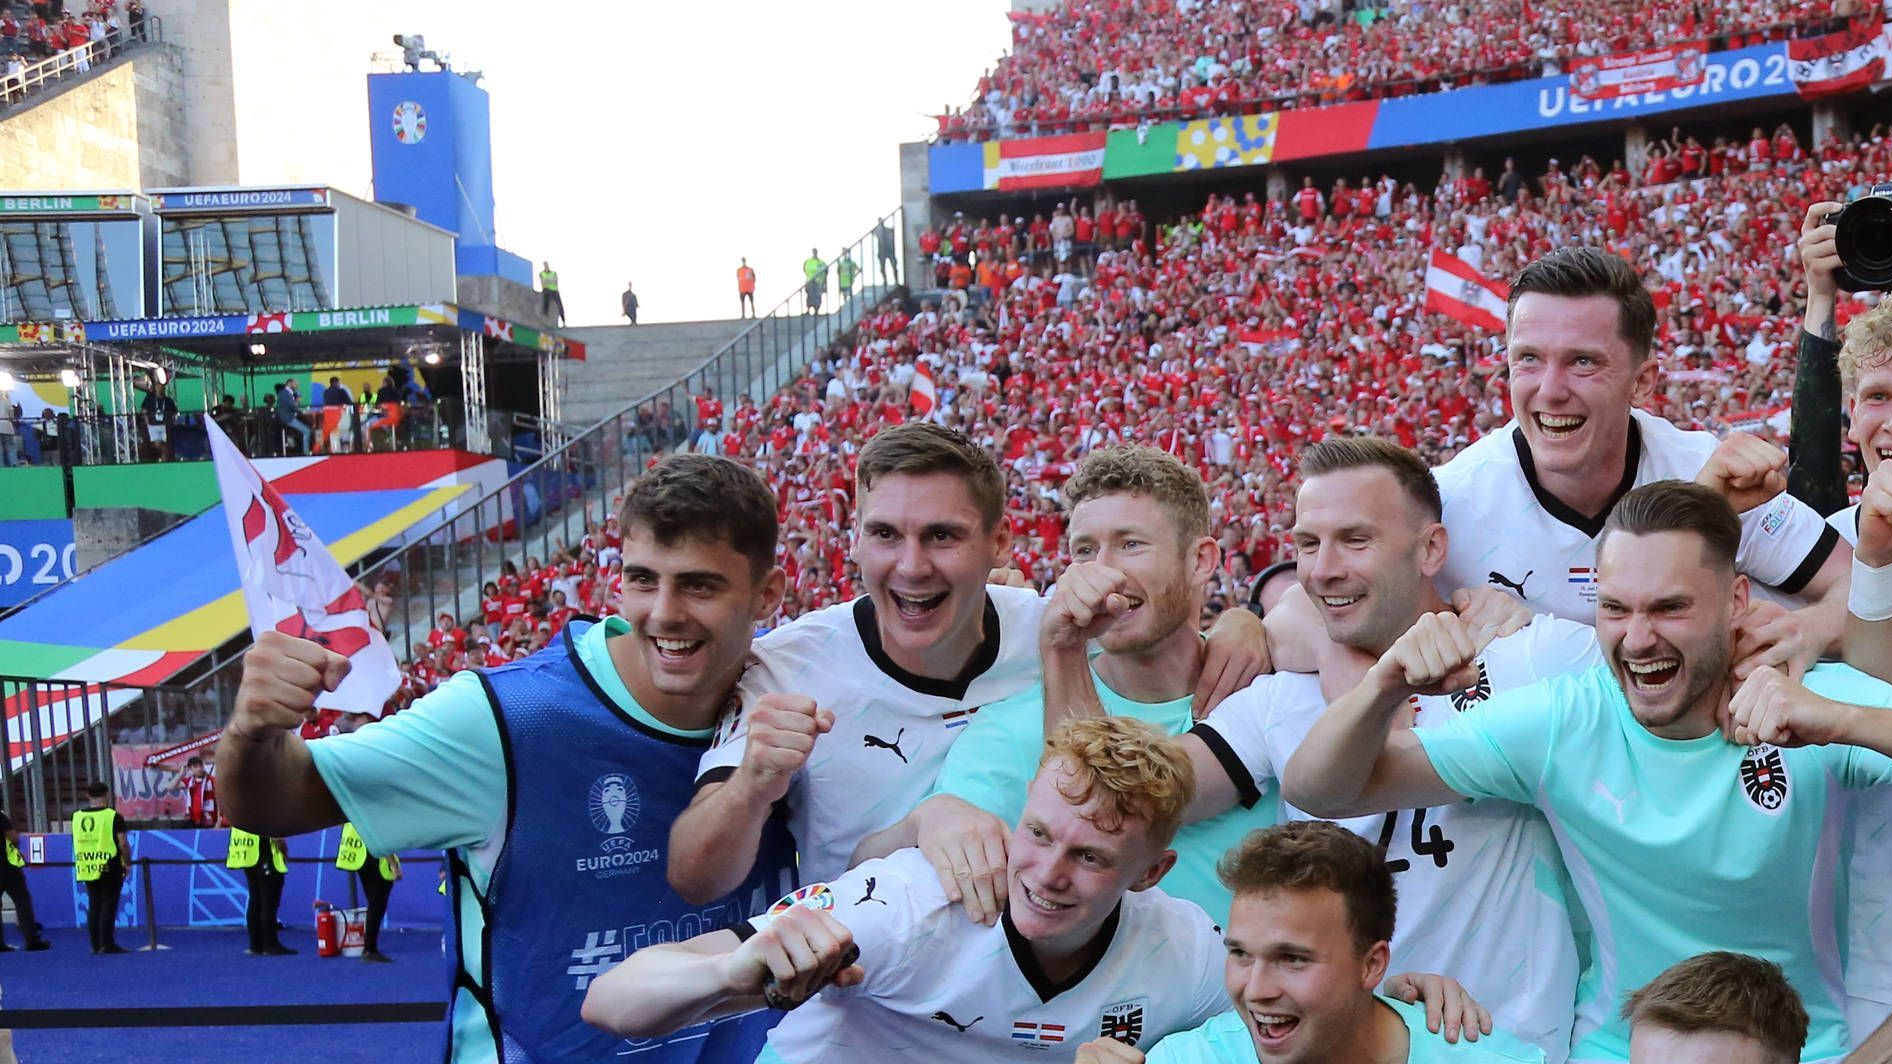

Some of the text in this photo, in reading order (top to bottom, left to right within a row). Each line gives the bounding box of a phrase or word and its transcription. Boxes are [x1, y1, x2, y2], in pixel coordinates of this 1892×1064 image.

[4, 197, 73, 210] BERLIN
[319, 309, 390, 327] BERLIN
[32, 838, 44, 857] H
[602, 838, 632, 851] UEFA
[576, 849, 659, 872] EURO2024
